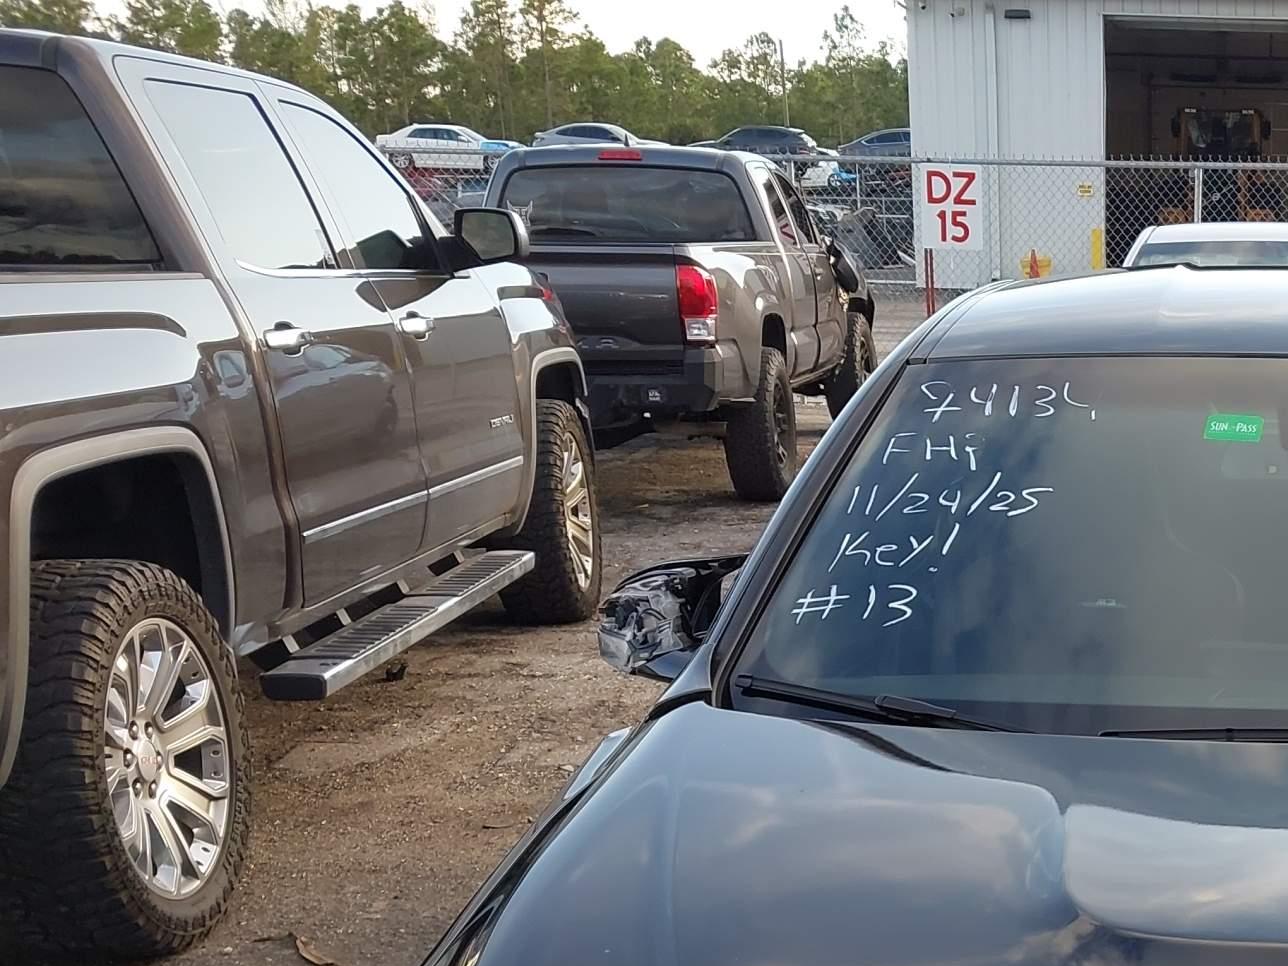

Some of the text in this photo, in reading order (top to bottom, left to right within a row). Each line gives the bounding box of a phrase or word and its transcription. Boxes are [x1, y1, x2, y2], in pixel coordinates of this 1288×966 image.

[926, 170, 976, 205] DZ
[936, 210, 970, 243] 15
[847, 471, 1054, 521] 11/24/25
